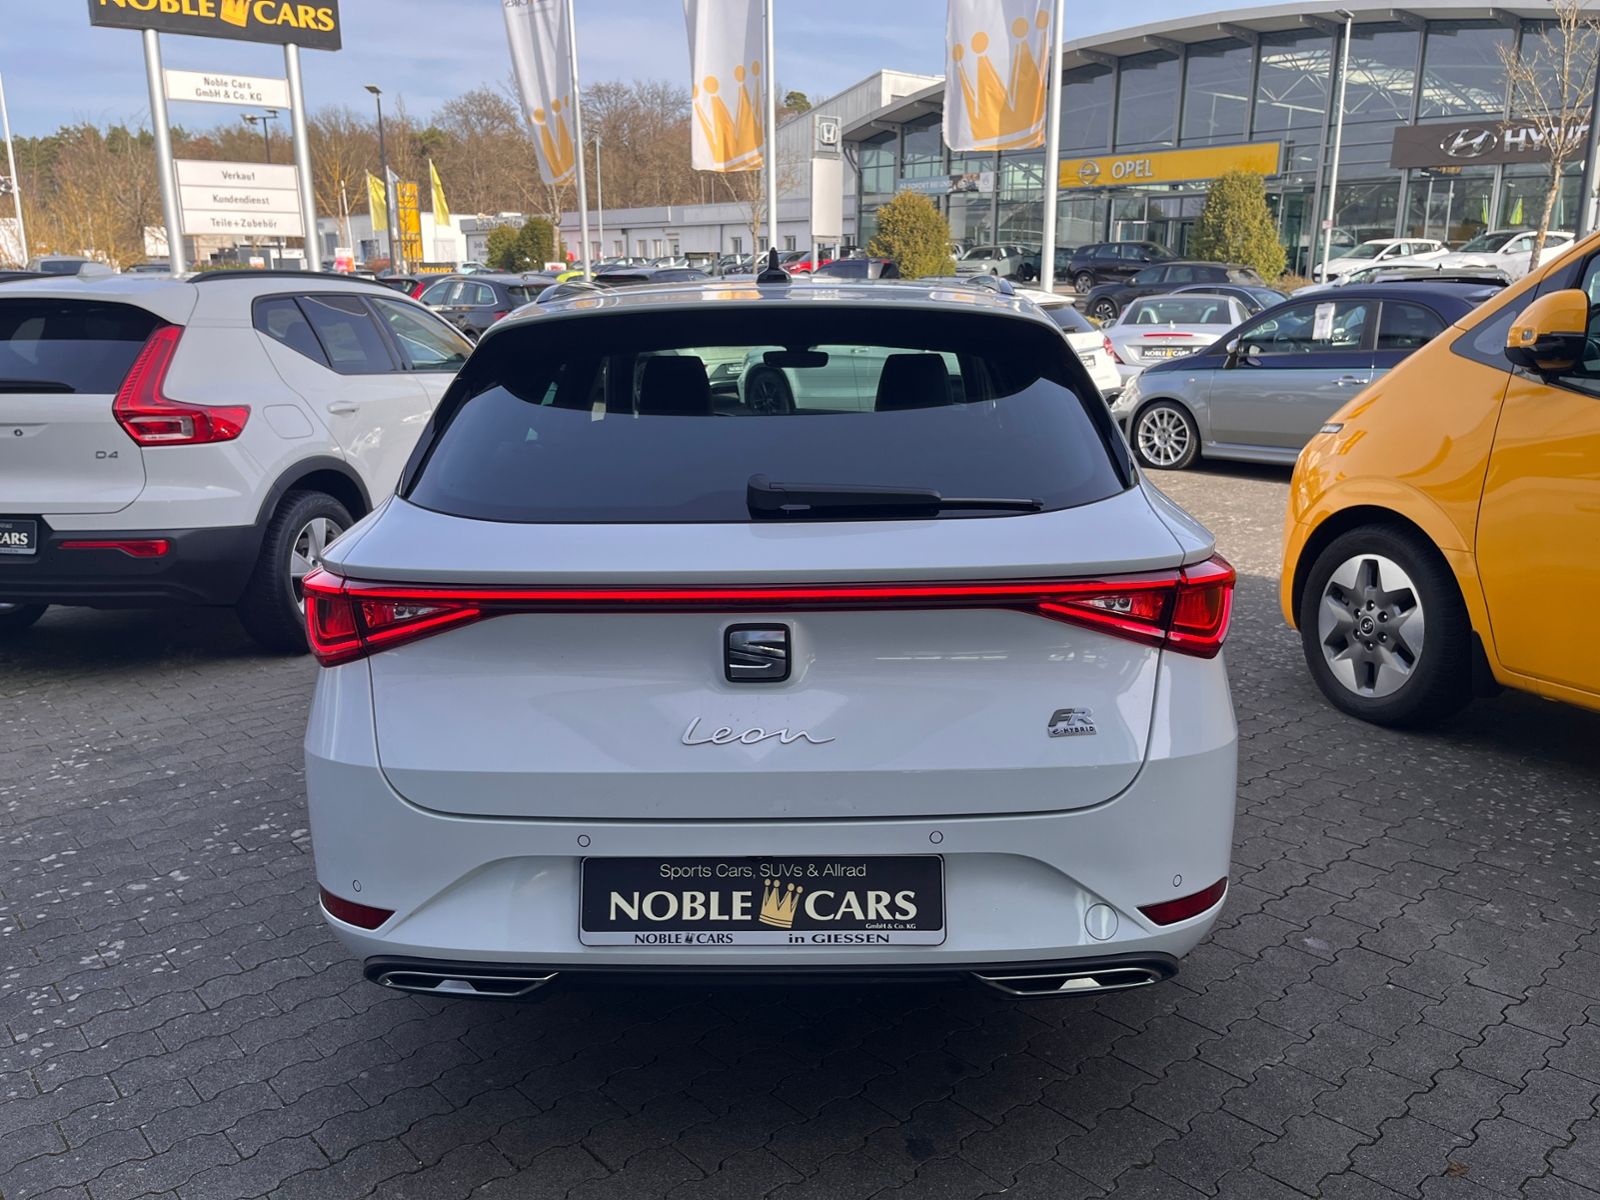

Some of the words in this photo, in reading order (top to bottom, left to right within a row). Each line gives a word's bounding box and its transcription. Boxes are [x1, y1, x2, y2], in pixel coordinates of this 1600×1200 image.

[99, 0, 216, 18] BLE
[253, 1, 335, 32] CARS
[203, 77, 229, 87] Noble
[231, 80, 252, 89] Cars
[195, 88, 221, 98] GmbH
[224, 91, 231, 99] &
[233, 91, 248, 100] Co.
[250, 93, 262, 101] KG
[221, 170, 256, 181] Verkauf
[1111, 159, 1153, 179] OPEL
[212, 194, 270, 205] Kundendienst
[95, 451, 119, 459] D4
[0, 532, 29, 545] ARS
[1048, 708, 1094, 727] FR
[677, 716, 836, 745] Leon
[659, 863, 712, 880] Sports
[715, 863, 756, 879] Cars,
[759, 863, 803, 877] SUVs
[806, 863, 820, 877] &
[822, 863, 867, 877] Allrad
[609, 890, 752, 921] NOBLE
[804, 890, 918, 921] CARS
[634, 933, 682, 944] NOBLE
[696, 933, 734, 944] CARS
[788, 933, 805, 944] in
[811, 933, 890, 944] GIESSEN
